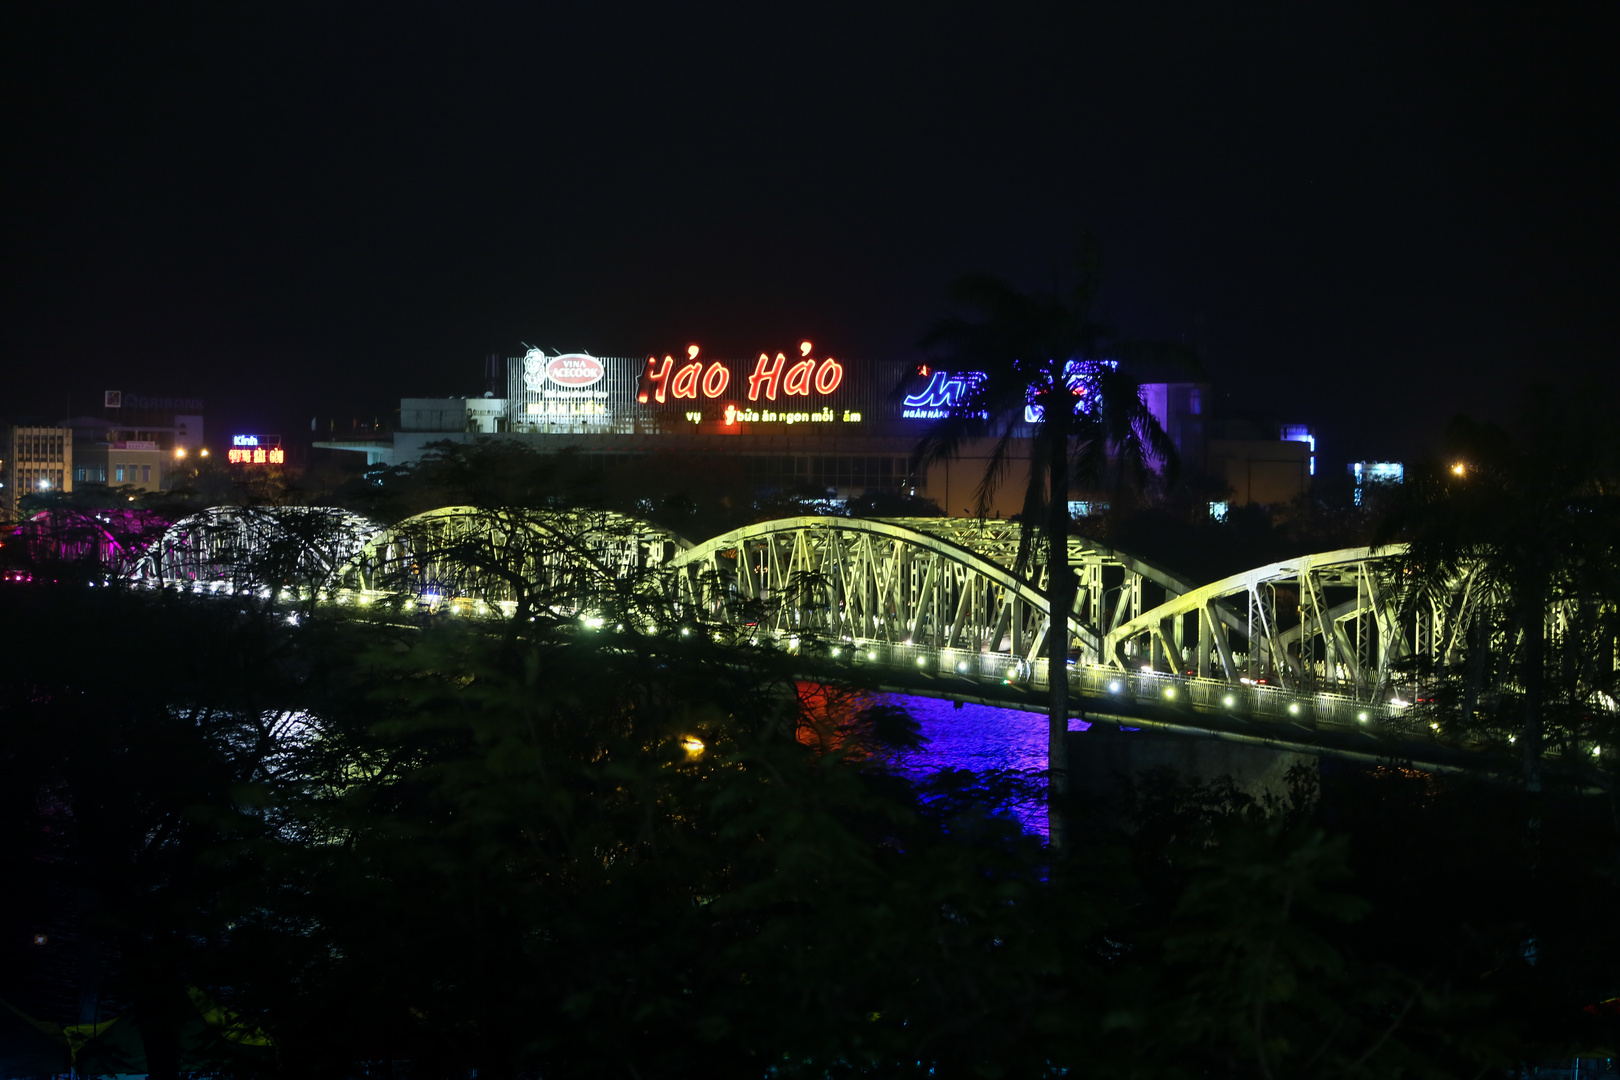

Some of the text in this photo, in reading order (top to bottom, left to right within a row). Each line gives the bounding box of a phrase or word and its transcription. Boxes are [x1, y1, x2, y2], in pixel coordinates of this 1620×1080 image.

[563, 360, 587, 368] VINA
[552, 368, 598, 378] ACECOOK
[636, 341, 843, 404] Hảo Hảo
[685, 411, 701, 425] vụ
[736, 408, 759, 422] bữa
[762, 409, 777, 422] ăn
[779, 412, 809, 425] ngon
[811, 406, 833, 422] mỗi
